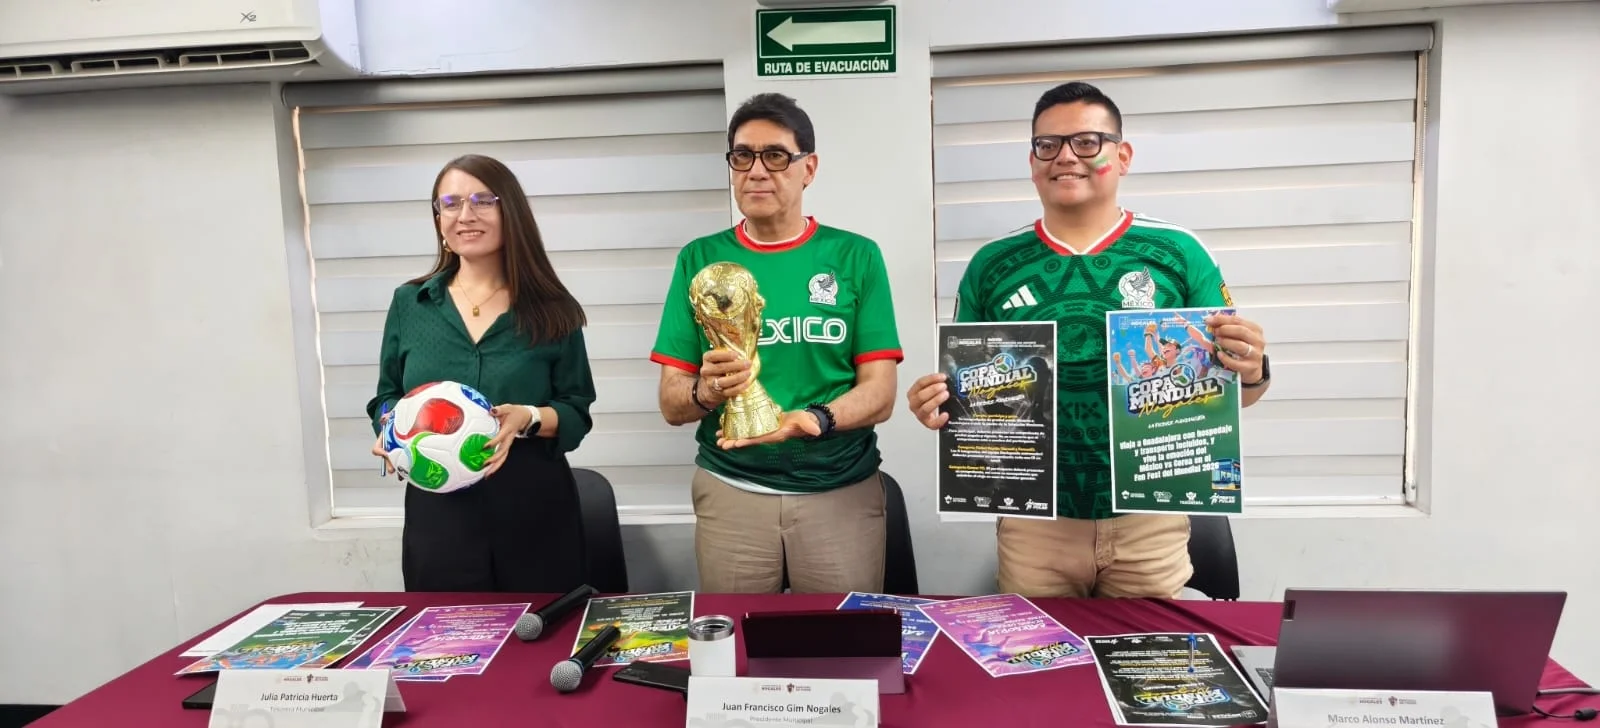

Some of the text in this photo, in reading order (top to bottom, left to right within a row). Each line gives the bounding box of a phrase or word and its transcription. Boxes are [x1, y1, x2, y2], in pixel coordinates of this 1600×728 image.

[240, 11, 257, 23] X2
[764, 57, 889, 74] RUTA DE EVACUACIÓN
[1122, 300, 1155, 308] MÉXICO
[959, 367, 1033, 393] MUNDIAL
[960, 364, 998, 382] COPA
[1128, 375, 1176, 398] COPA
[1129, 379, 1219, 411] MUNDIAL
[1138, 394, 1212, 418] Nogales
[1119, 440, 1136, 450] Viaja
[1142, 433, 1182, 447] Guadalajara
[1183, 431, 1196, 440] con
[1197, 424, 1233, 438] hospedaje
[1140, 442, 1175, 456] transporte
[1142, 446, 1207, 464] vive la emoción del
[1173, 458, 1193, 468] Corea
[1194, 457, 1203, 465] en
[1134, 461, 1220, 482] Fan Fest del Mundial 2026
[261, 692, 339, 702] Julia Patricia Huerta
[722, 702, 842, 715] Juan Francisco Gim Nogales
[1328, 713, 1445, 726] Marco Alonso Martínez
